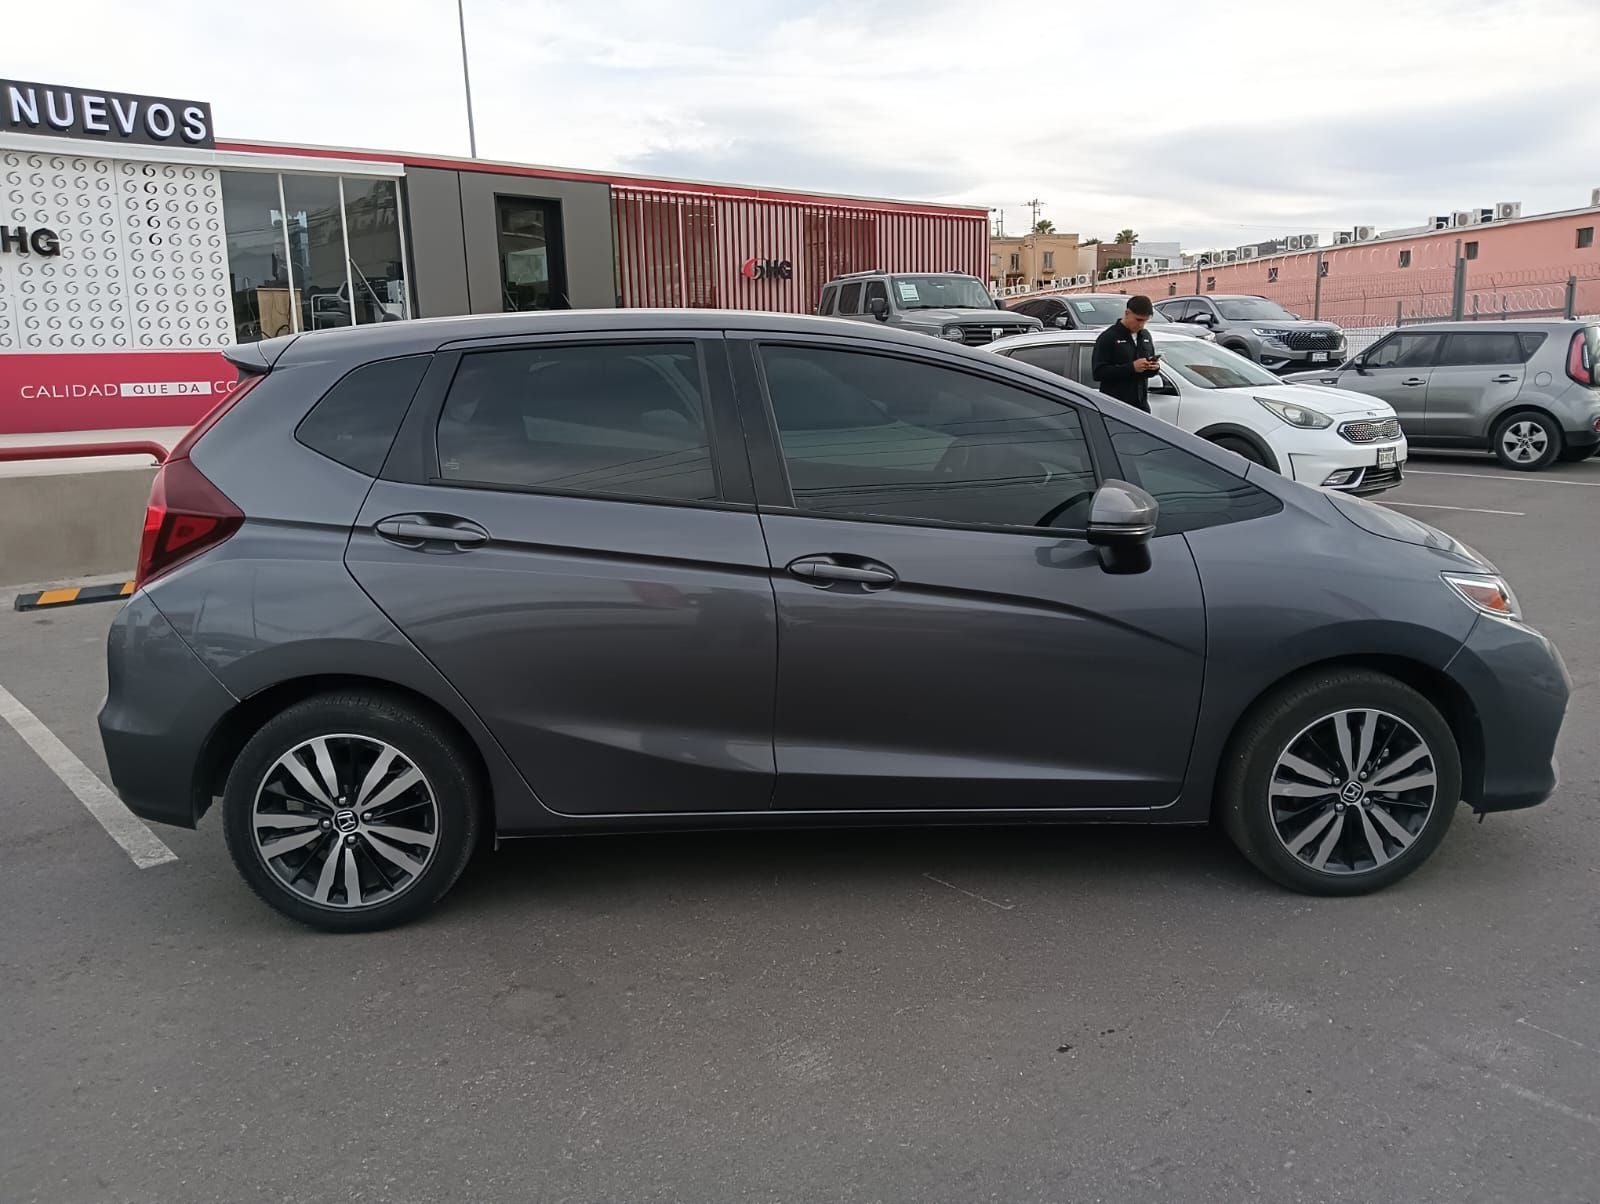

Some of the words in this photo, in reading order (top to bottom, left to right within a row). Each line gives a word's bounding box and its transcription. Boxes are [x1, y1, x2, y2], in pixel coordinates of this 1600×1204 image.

[8, 86, 208, 142] NUEVOS
[0, 226, 61, 256] HG
[21, 383, 118, 399] CALIDAD
[133, 383, 168, 395] QUE
[178, 383, 200, 394] DA
